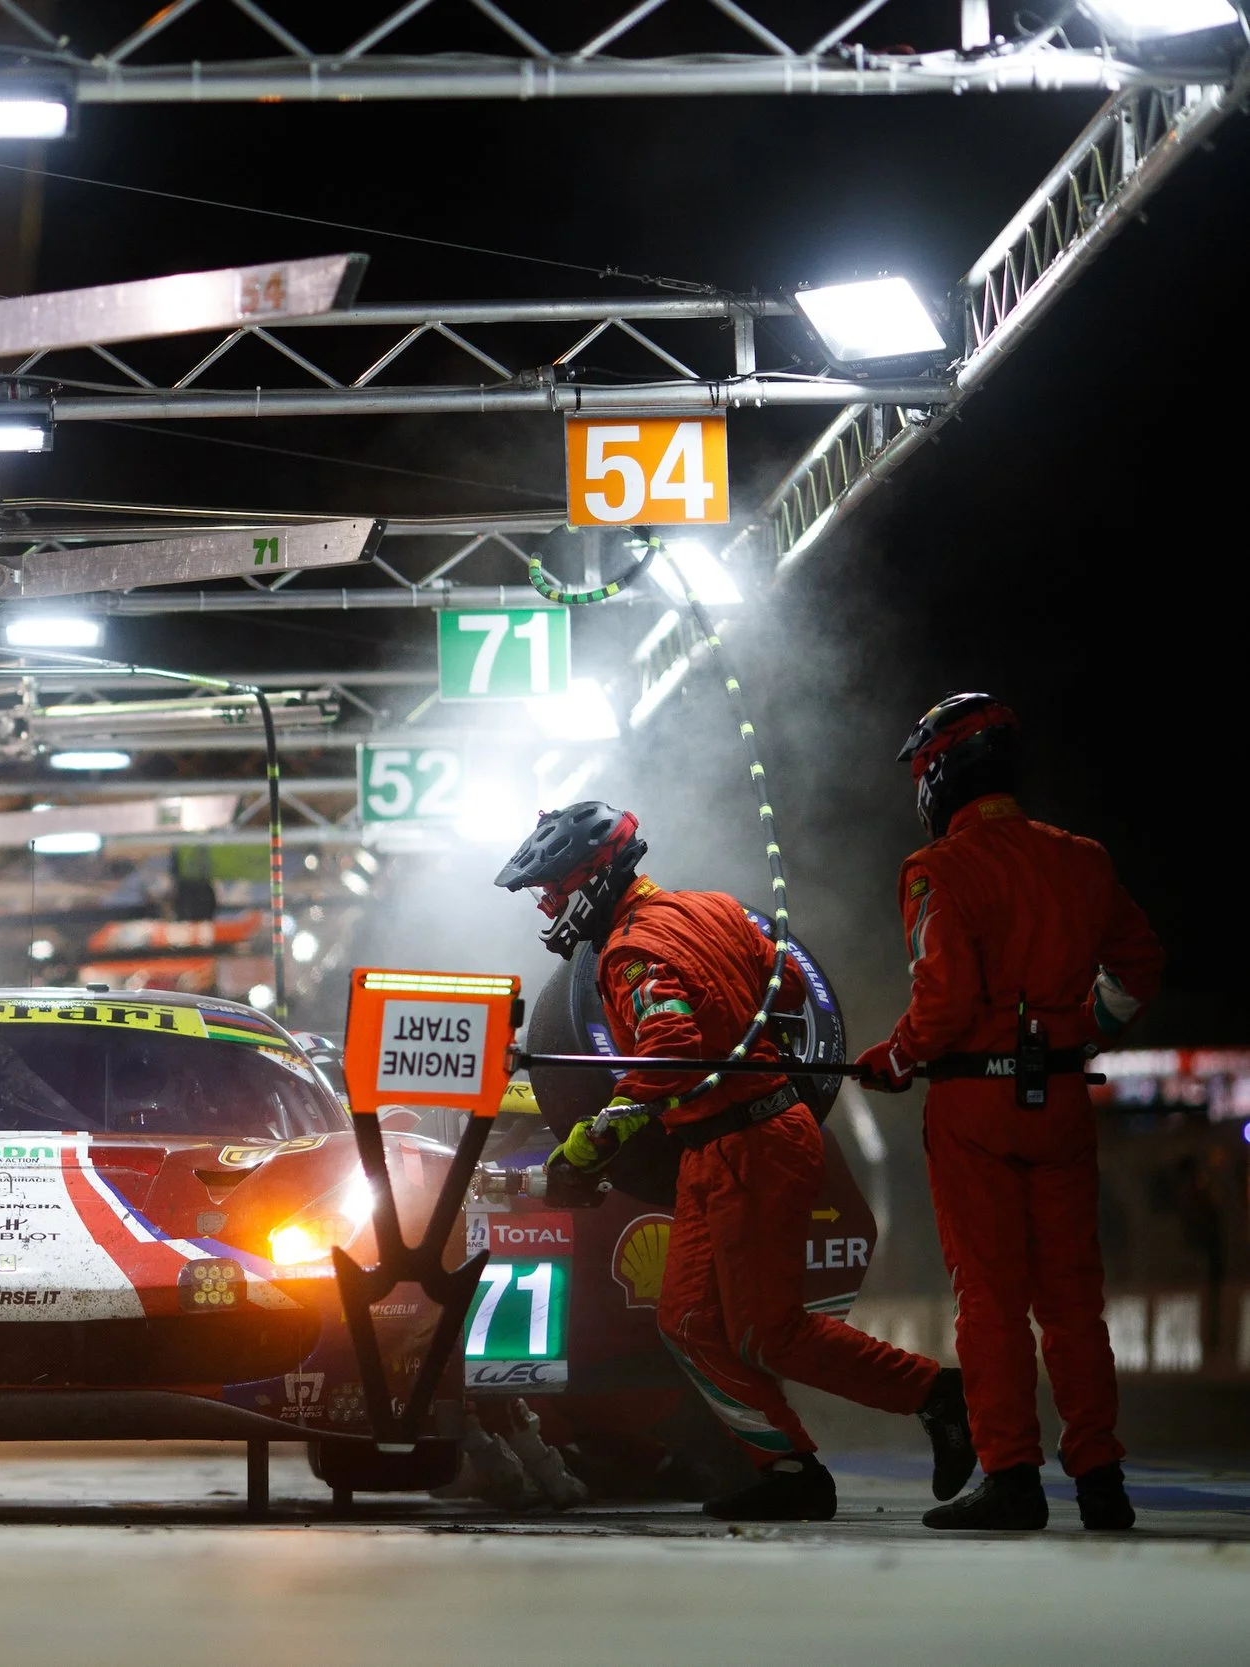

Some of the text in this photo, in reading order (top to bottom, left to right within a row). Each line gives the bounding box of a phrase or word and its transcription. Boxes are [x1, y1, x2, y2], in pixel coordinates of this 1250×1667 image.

[584, 421, 714, 522] 54
[252, 536, 279, 566] 71
[458, 612, 550, 694] 71
[367, 750, 461, 818] 52
[393, 1016, 471, 1043] START
[383, 1051, 476, 1079] ENGINE
[465, 1262, 552, 1356] 71
[472, 1362, 553, 1384] WEC
